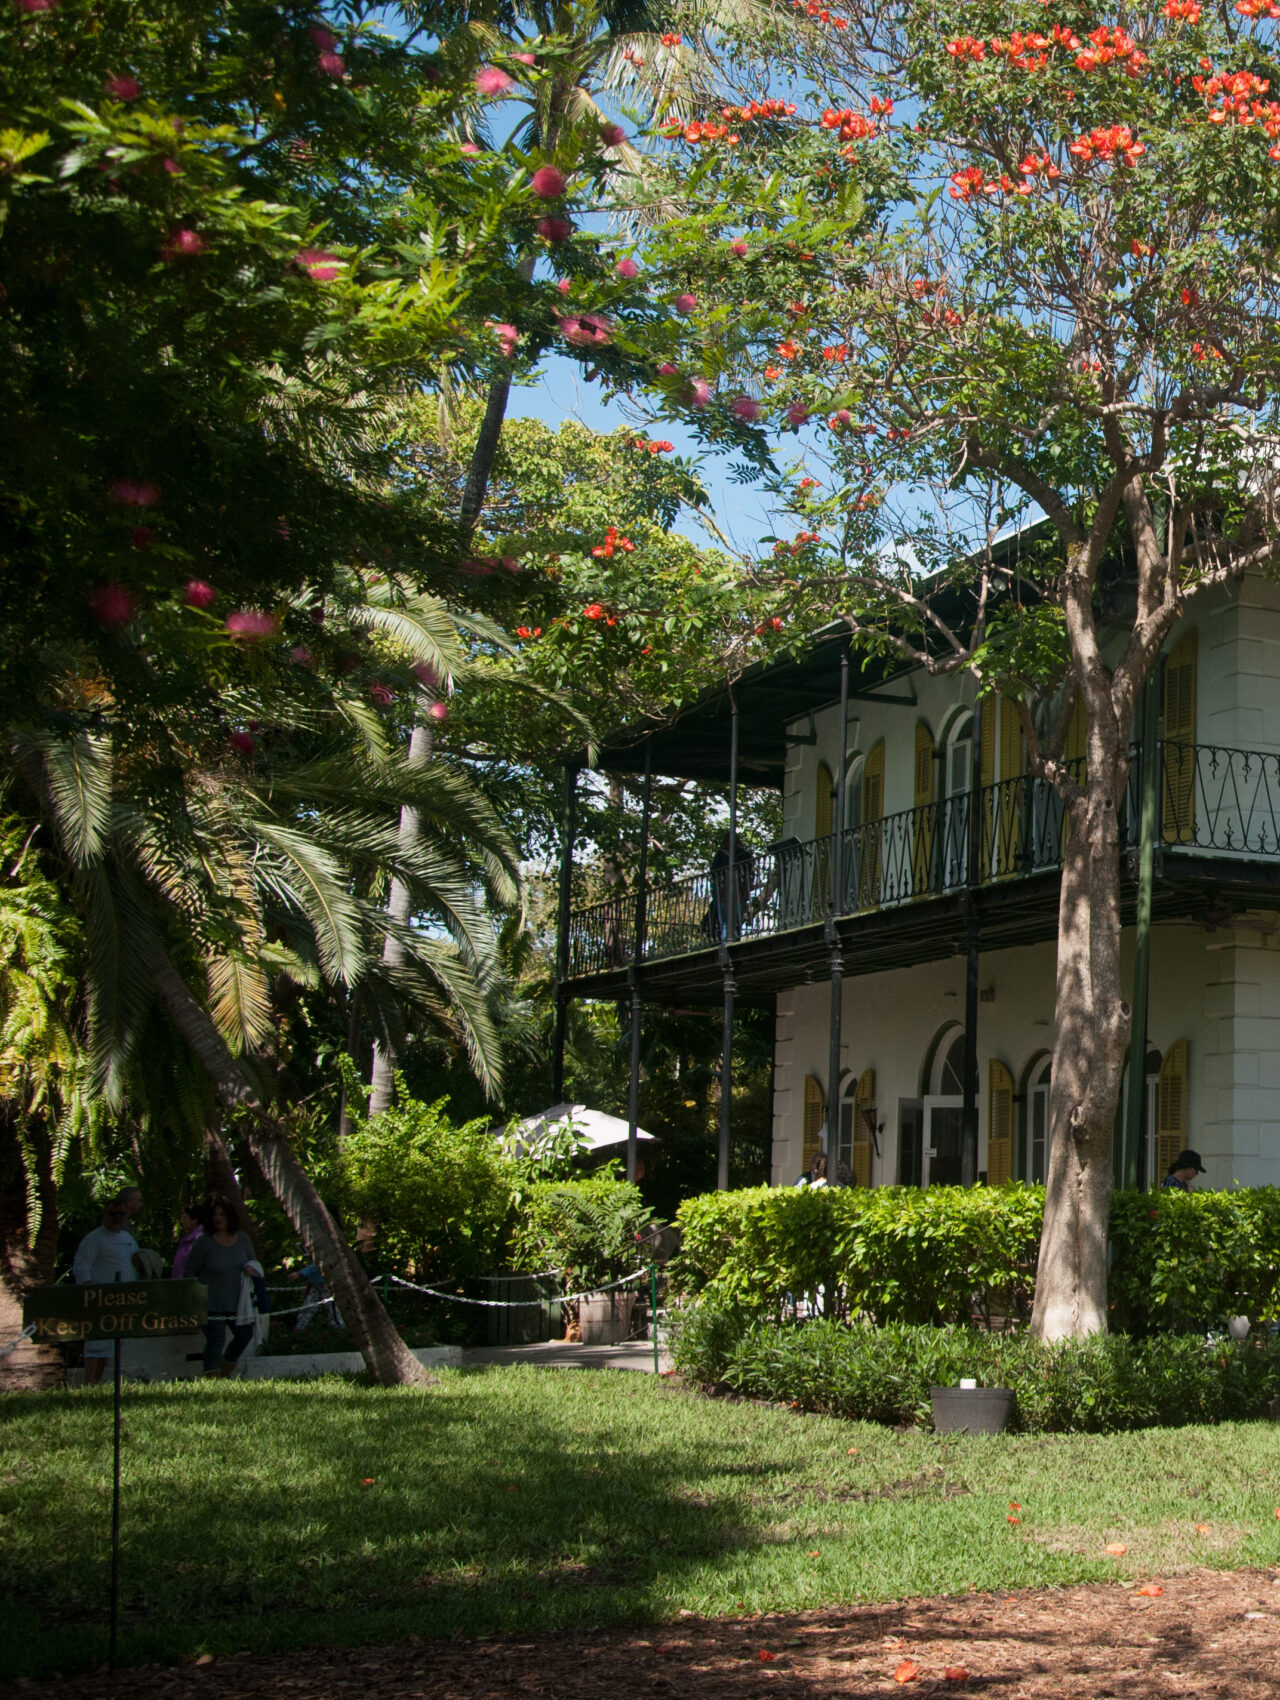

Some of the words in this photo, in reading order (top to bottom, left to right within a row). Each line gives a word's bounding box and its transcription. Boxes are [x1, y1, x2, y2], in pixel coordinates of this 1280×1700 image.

[83, 1288, 149, 1308] Please
[37, 1316, 93, 1339] Keep
[99, 1312, 138, 1333] Off
[141, 1311, 199, 1330] Grass
